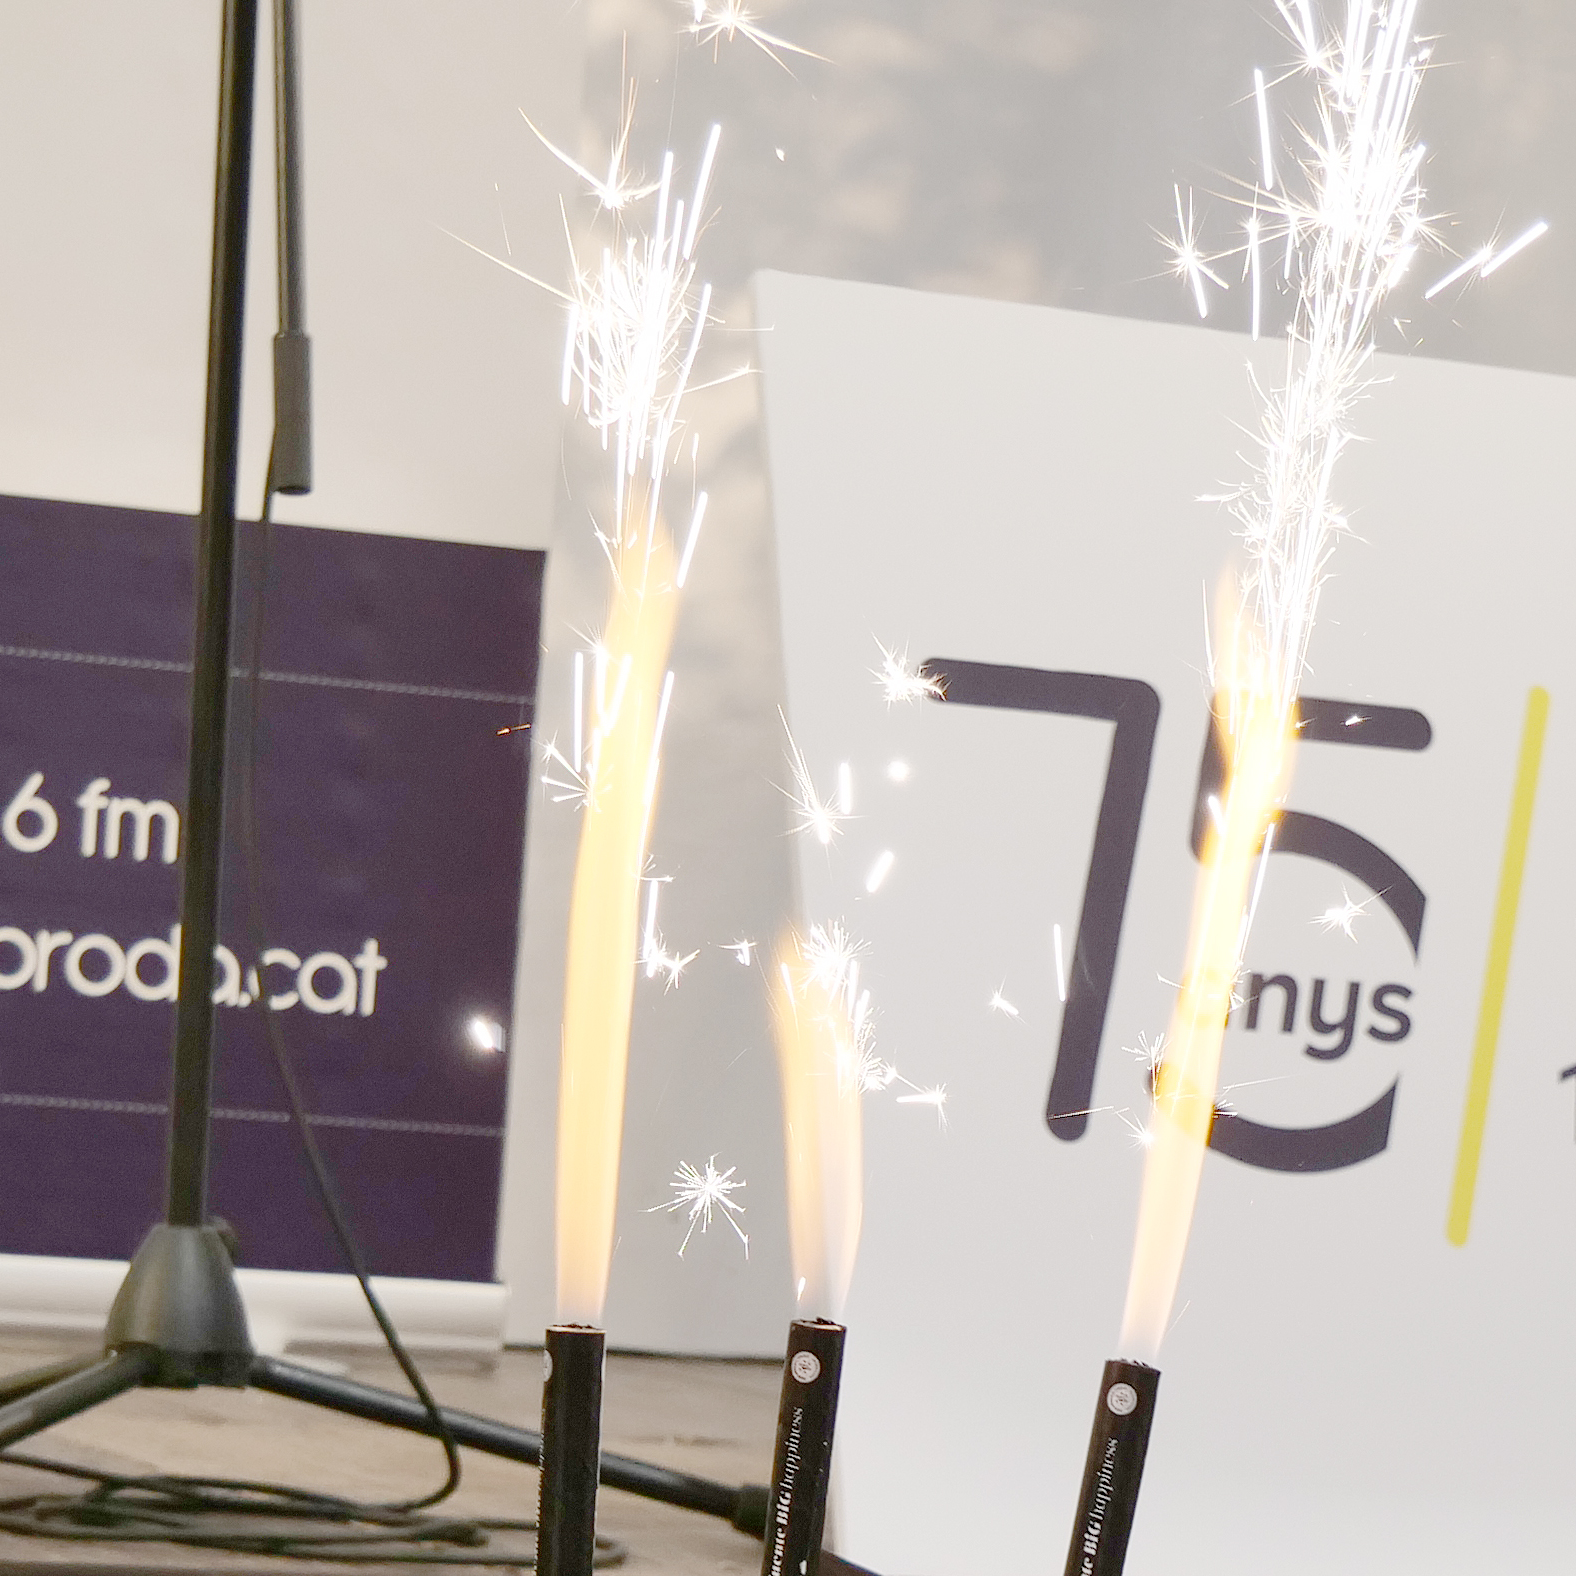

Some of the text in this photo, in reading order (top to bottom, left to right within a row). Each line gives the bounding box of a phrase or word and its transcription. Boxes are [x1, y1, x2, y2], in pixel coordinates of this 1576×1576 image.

[76, 777, 181, 865] fm
[920, 656, 1432, 1174] 75
[1179, 970, 1414, 1061] nys
